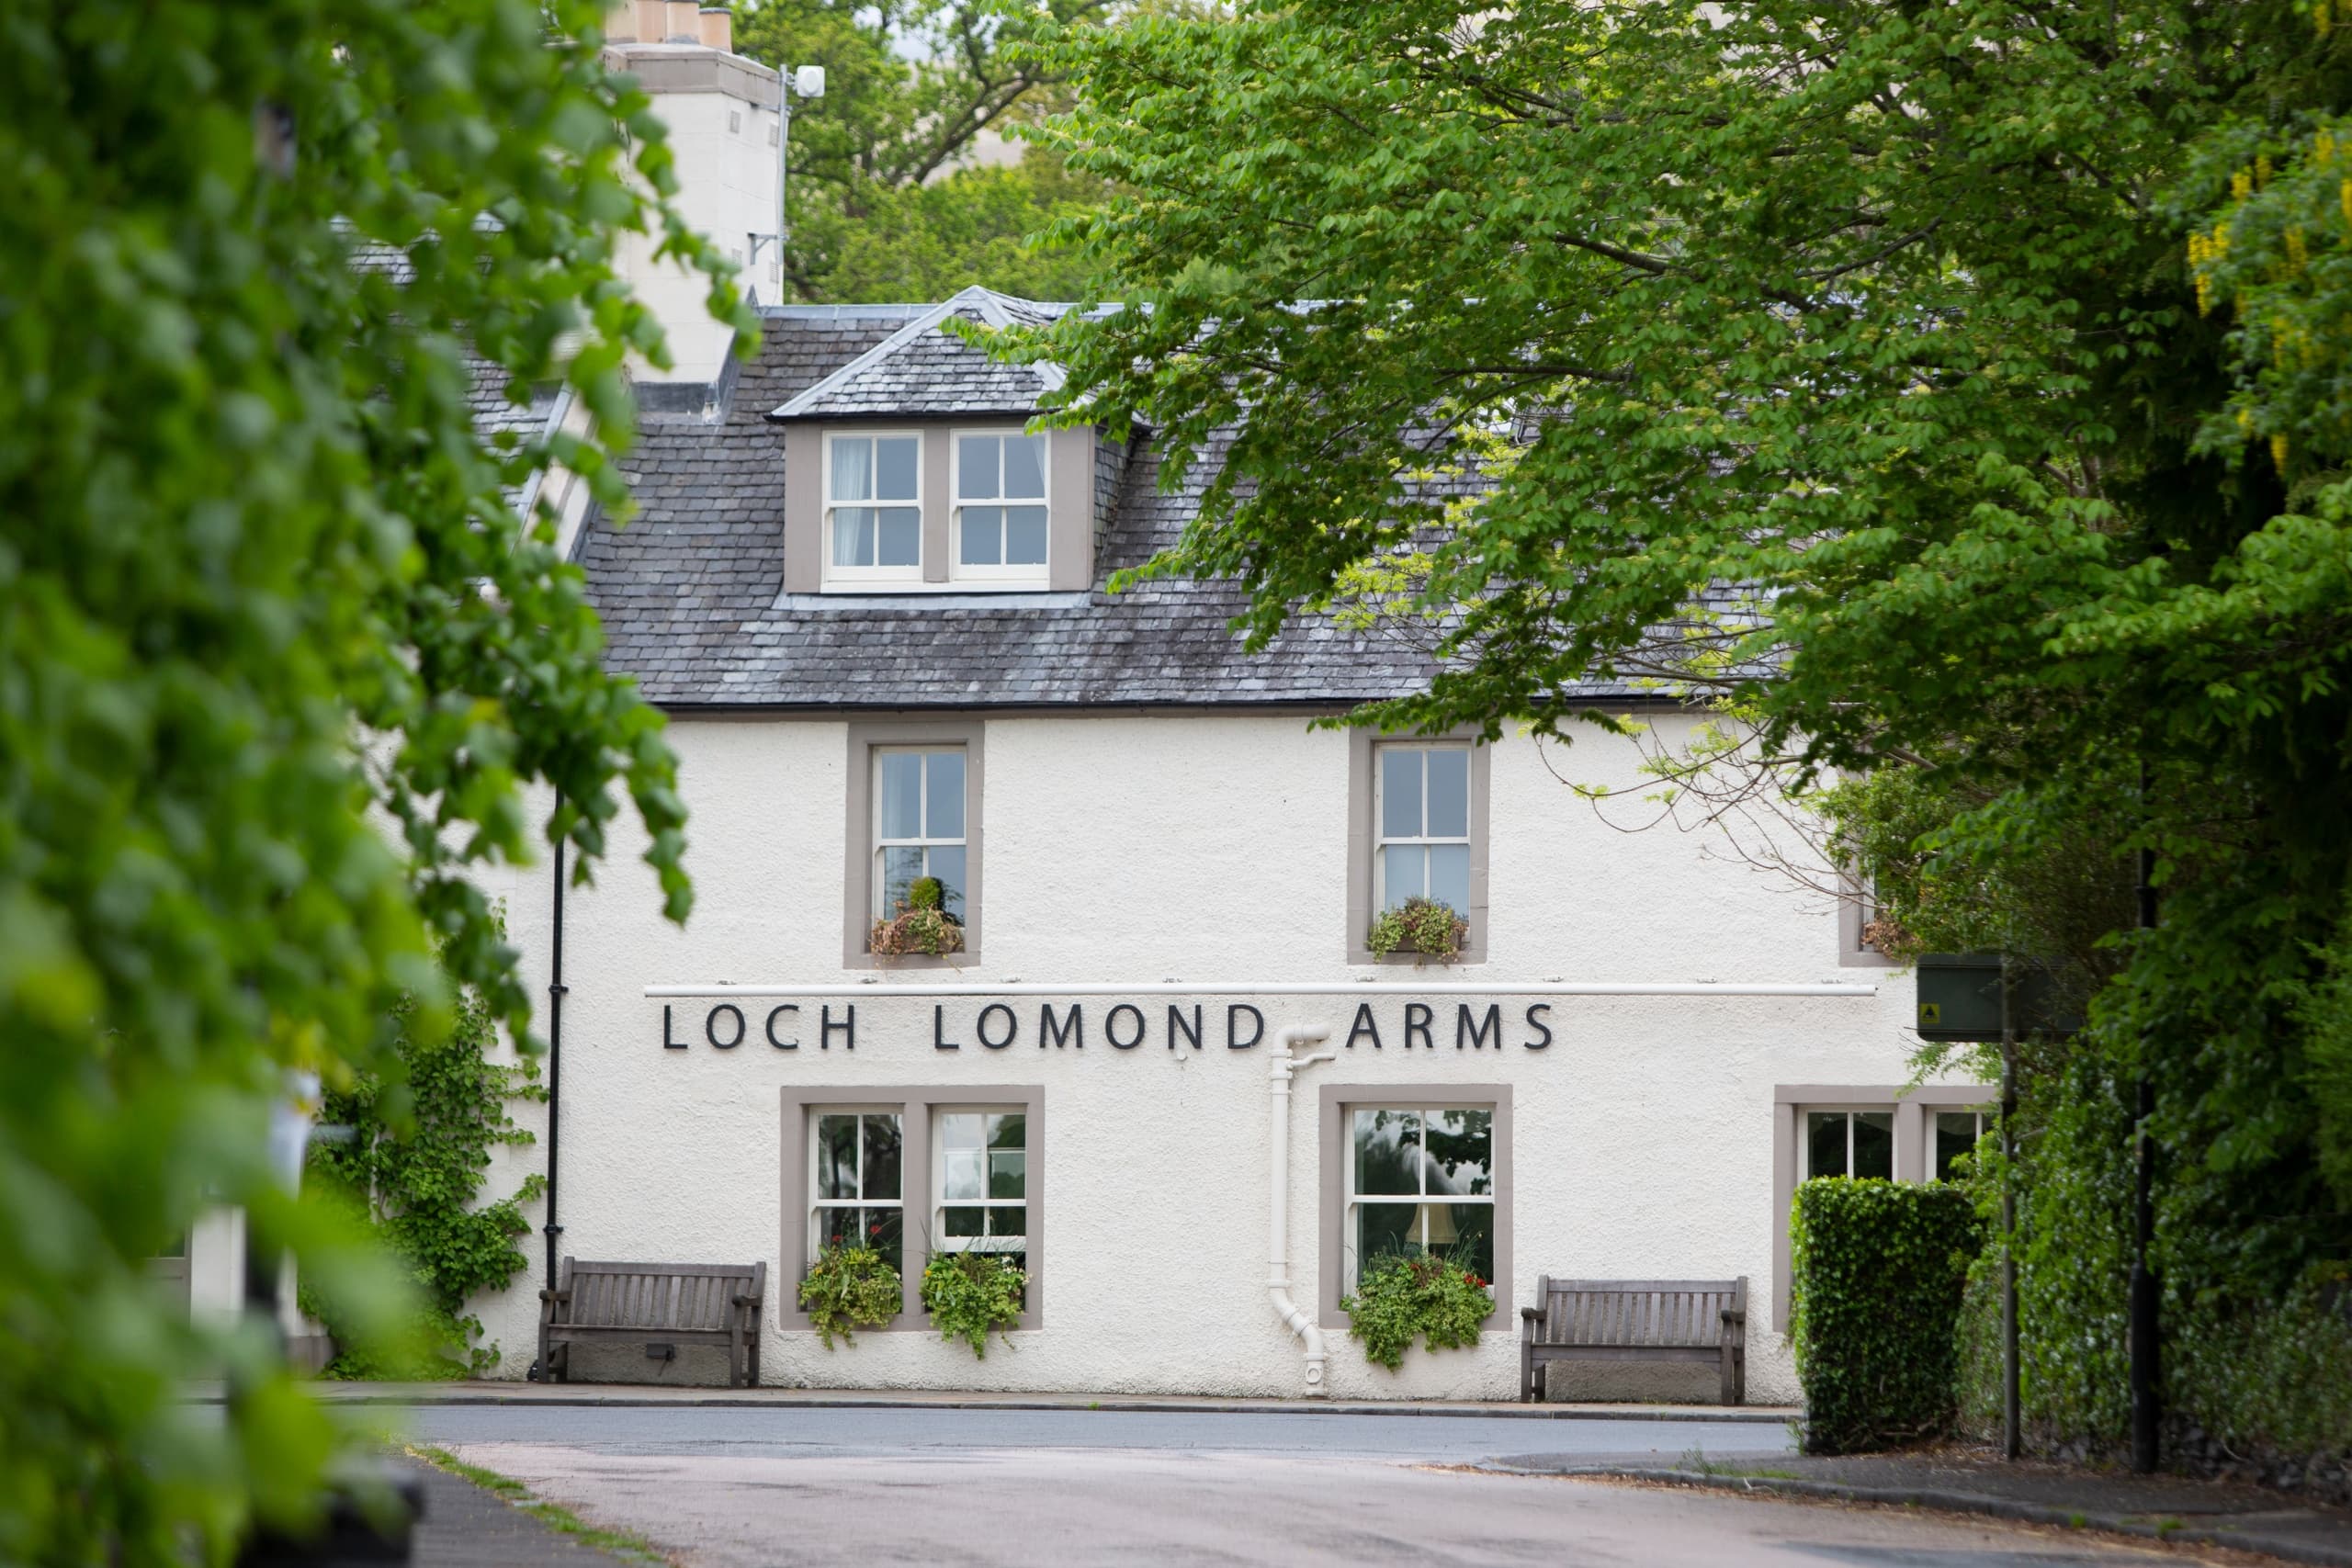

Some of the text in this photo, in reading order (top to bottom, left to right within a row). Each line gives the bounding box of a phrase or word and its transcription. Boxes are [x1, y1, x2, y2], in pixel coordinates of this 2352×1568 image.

[663, 1002, 1552, 1052] LOCH LOMOND ARMS
